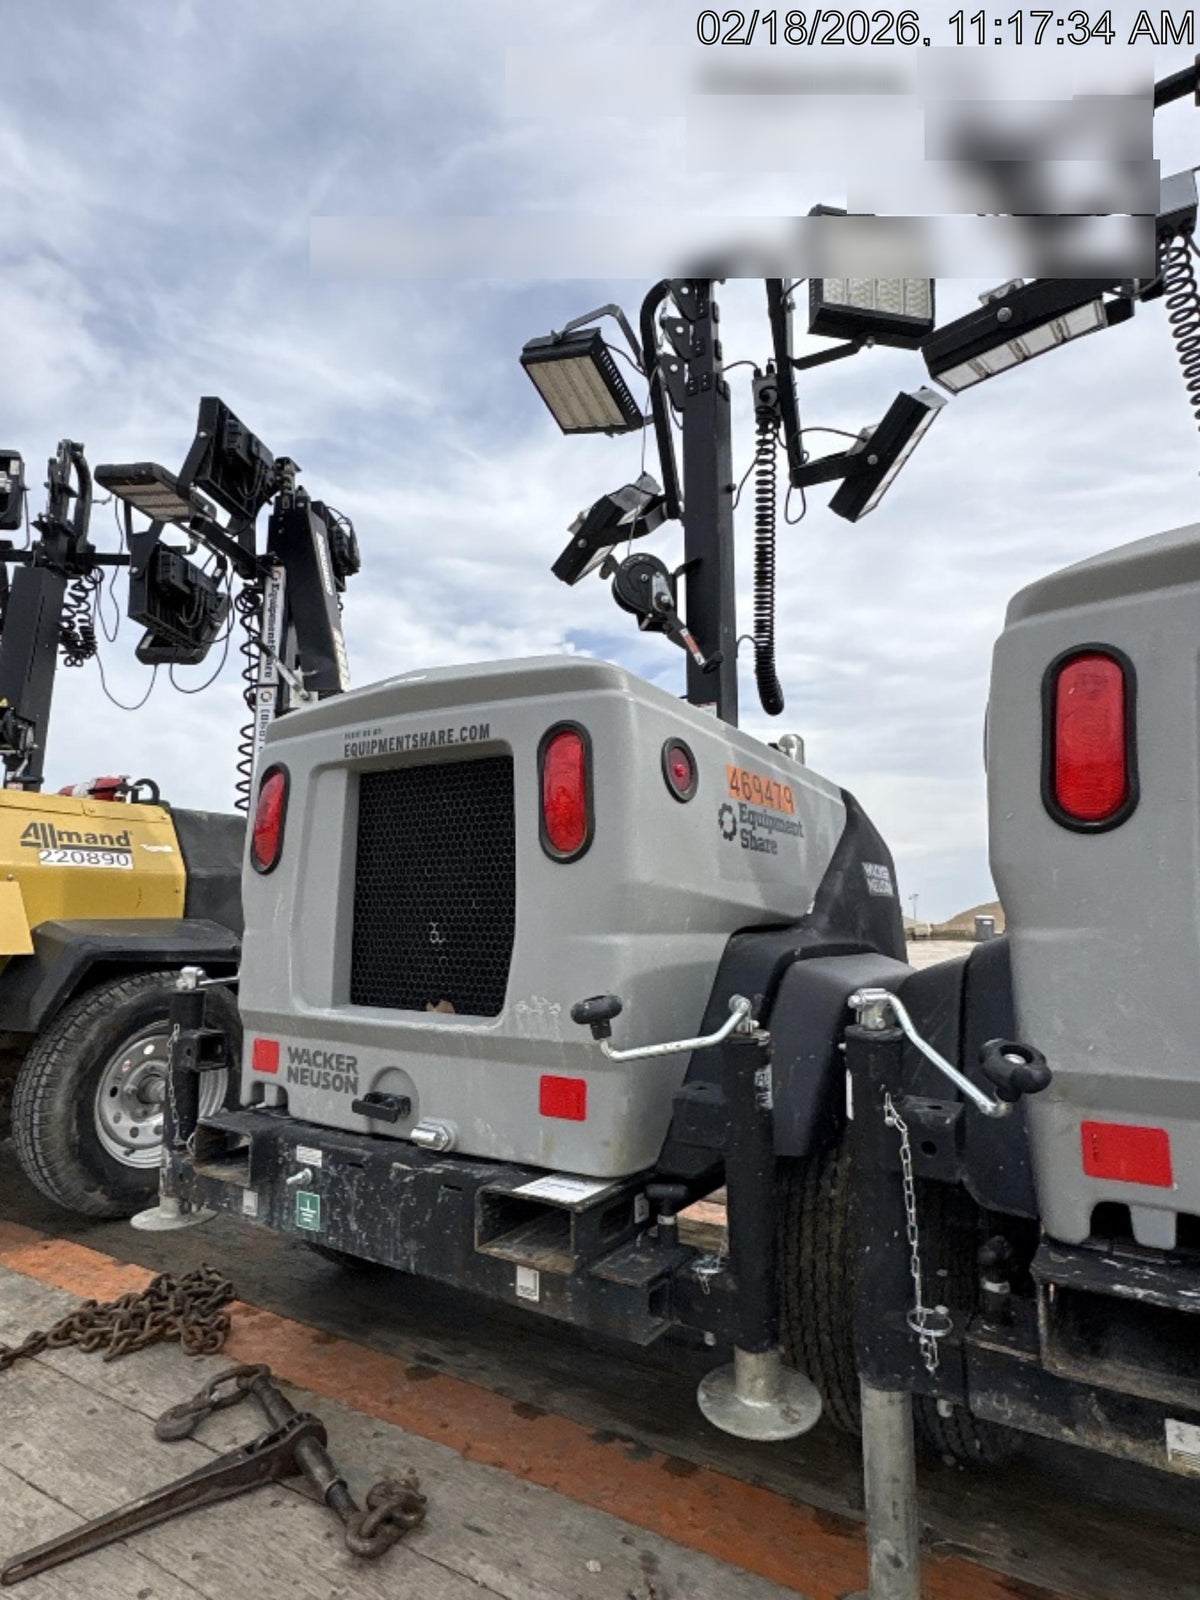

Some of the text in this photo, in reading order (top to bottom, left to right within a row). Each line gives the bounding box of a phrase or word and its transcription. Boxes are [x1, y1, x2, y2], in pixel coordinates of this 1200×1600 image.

[265, 582, 280, 678] EquipmentSare
[344, 723, 490, 758] EQUIPMENTSHARE.COM
[730, 766, 795, 814] 469479
[738, 801, 804, 838] Equipment
[21, 822, 132, 849] Allmand
[741, 828, 778, 855] Share
[41, 850, 129, 867] 220890
[287, 1046, 359, 1075] WACKER
[287, 1066, 360, 1095] NEUSON
